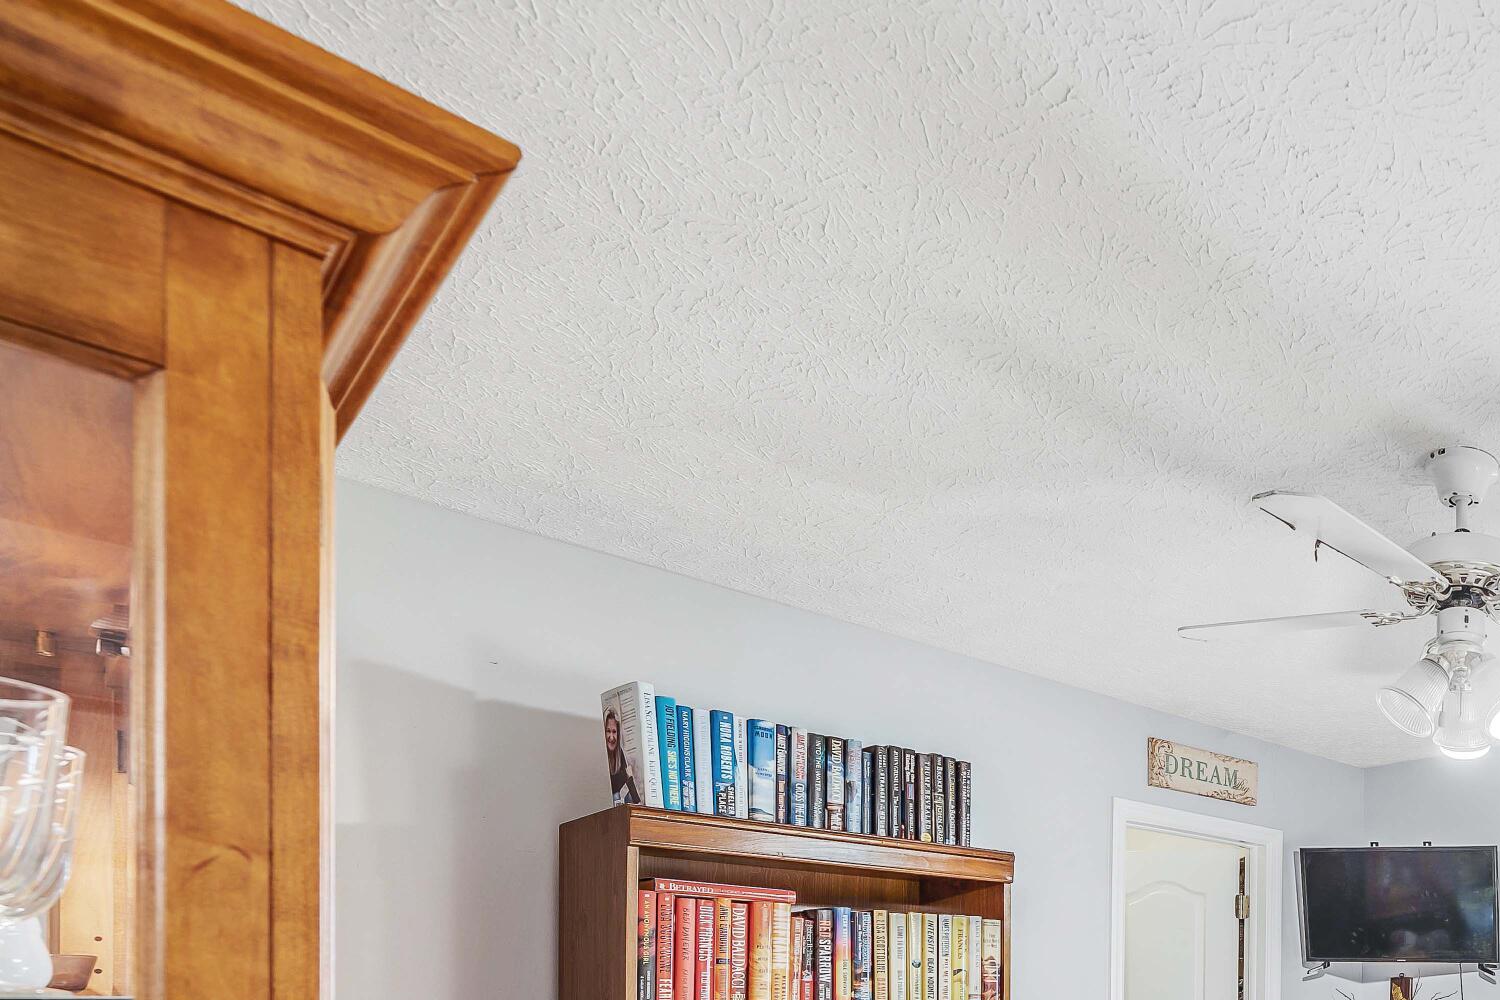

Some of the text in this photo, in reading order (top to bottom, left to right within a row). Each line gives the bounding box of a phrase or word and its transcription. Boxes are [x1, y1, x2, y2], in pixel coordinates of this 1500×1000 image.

[665, 705, 673, 716] JOY
[666, 718, 676, 748] FIELDING
[720, 722, 733, 779] NORA ROBERTS
[831, 739, 842, 804] DAVID BALDACCI
[1165, 754, 1239, 787] DREAM
[670, 784, 680, 805] THERE
[718, 792, 726, 813] PLACE
[669, 883, 713, 893] BETRAYED
[644, 900, 649, 909] AN
[699, 906, 713, 961] DICK FRANCIS
[876, 919, 885, 934] LISA
[732, 907, 745, 988] DAVID BALDACCI
[818, 919, 831, 982] RED SPARROW
[876, 936, 885, 974] SCOTTOLINE
[927, 976, 935, 1000] KOONTZ
